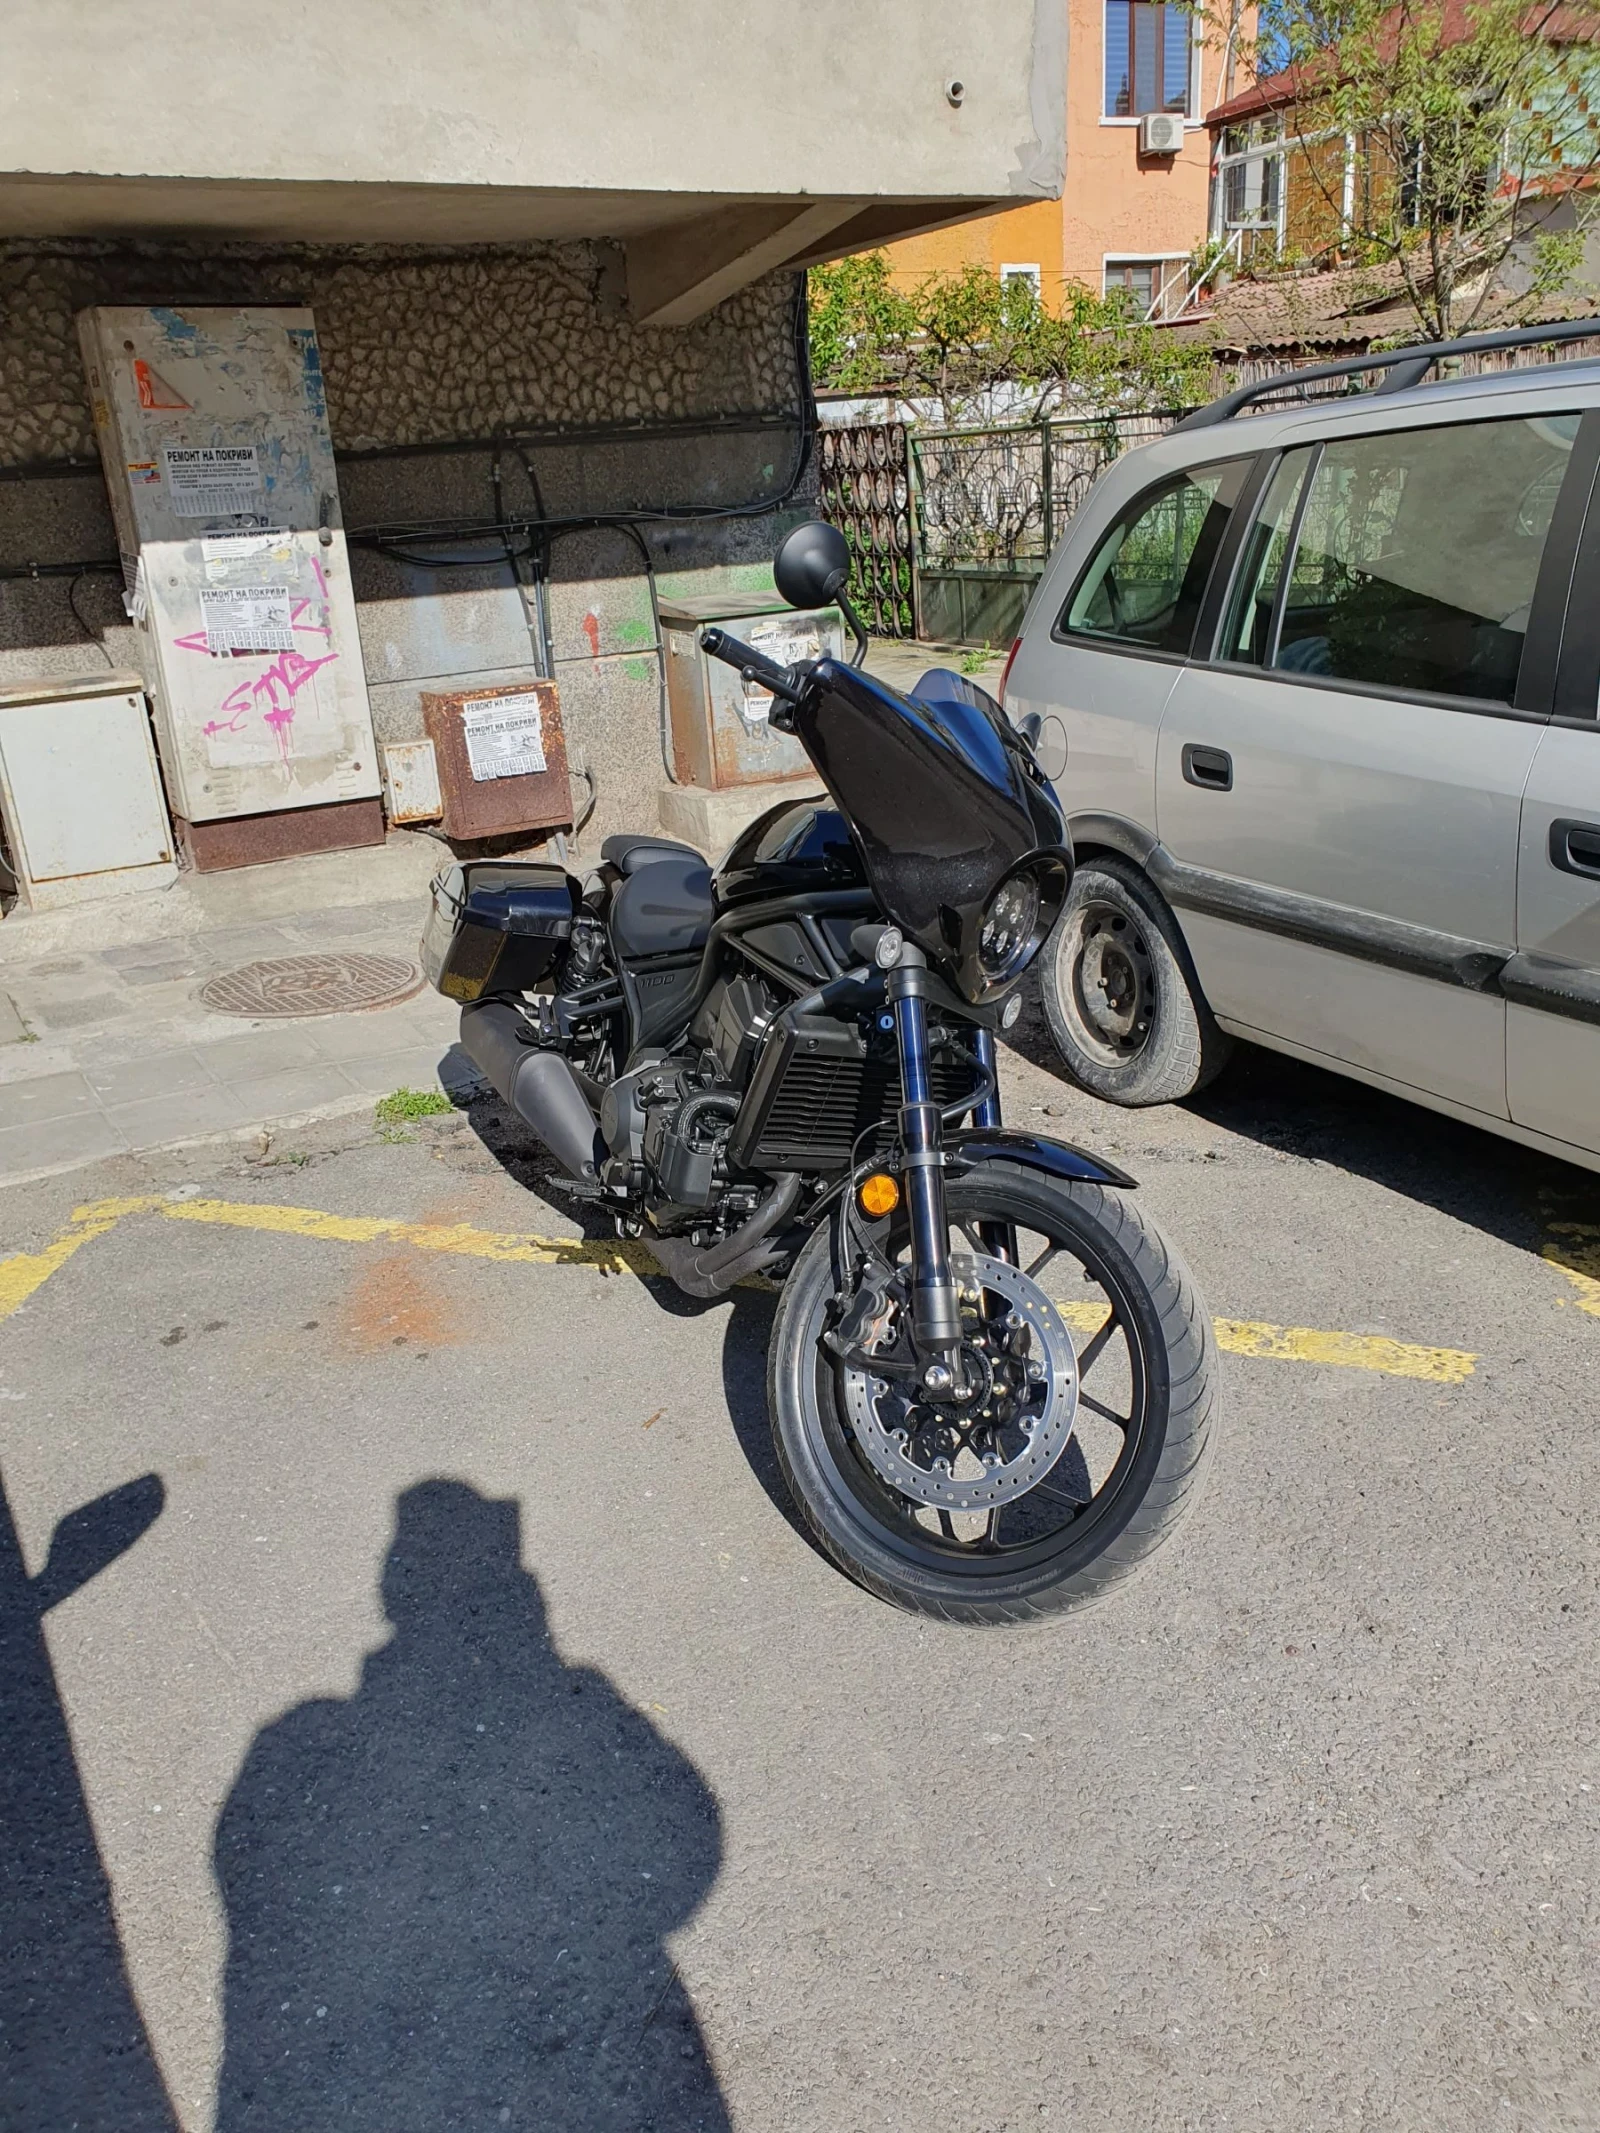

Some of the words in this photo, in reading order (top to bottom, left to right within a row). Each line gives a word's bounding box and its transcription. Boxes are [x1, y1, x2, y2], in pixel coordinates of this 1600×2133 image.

[167, 450, 200, 462] РЕМОНТ
[202, 450, 214, 461] НА
[215, 449, 253, 460] ПОКРИВИ
[202, 590, 233, 599] РЕМОНТ
[248, 588, 286, 596] ПОКРИВИ
[467, 701, 492, 712] РЕМОНТ
[494, 700, 503, 708] НА
[467, 724, 493, 735] РЕМОНТ
[505, 718, 536, 728] ПОКРИВИ
[641, 974, 675, 988] 1100
